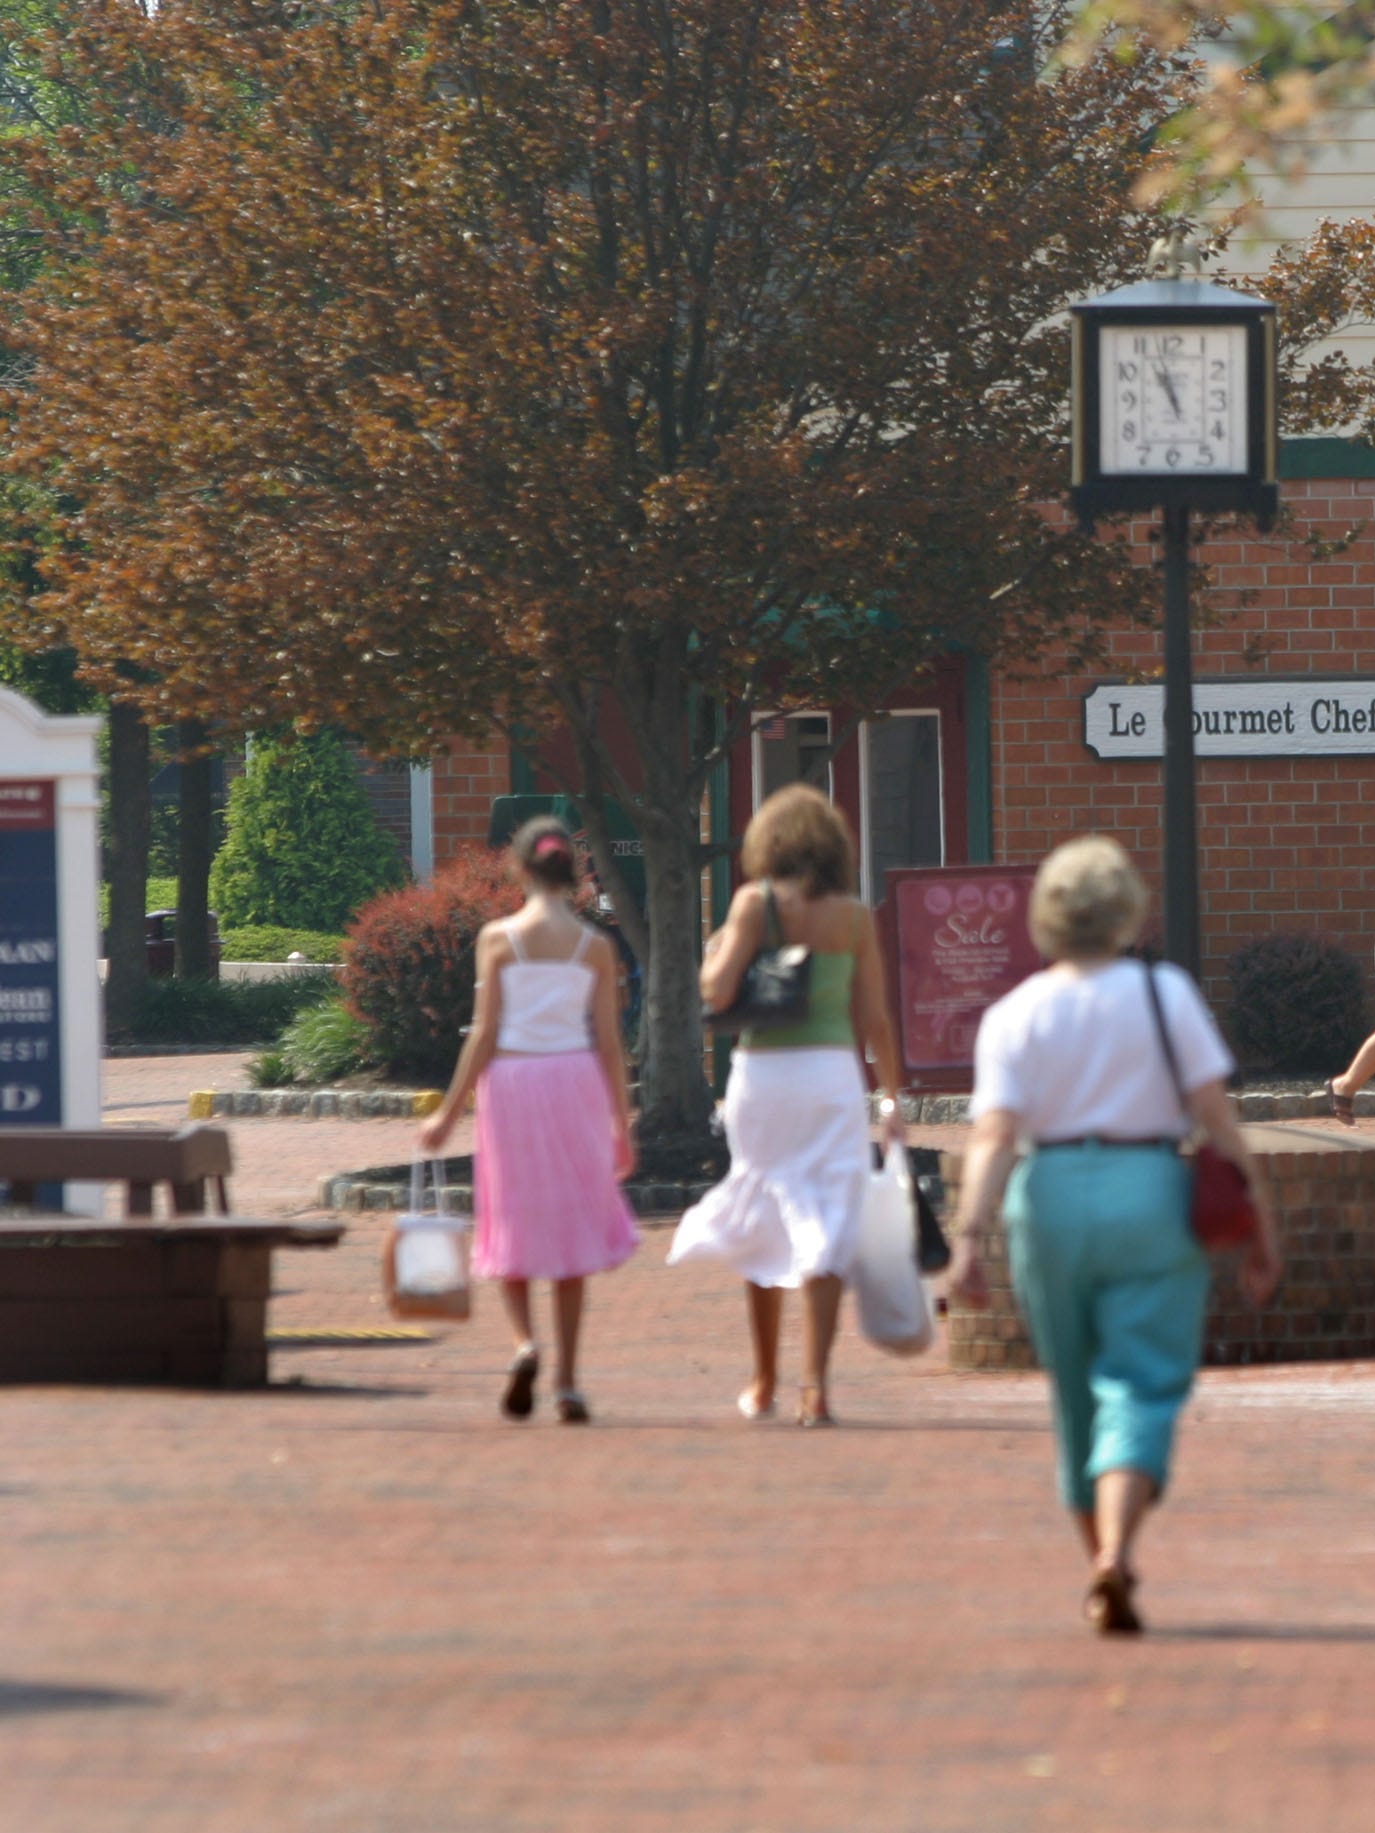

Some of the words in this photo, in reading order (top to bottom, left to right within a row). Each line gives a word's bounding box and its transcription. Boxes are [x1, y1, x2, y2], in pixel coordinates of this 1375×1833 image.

[1133, 338, 1147, 355] 11
[1162, 337, 1183, 355] 12
[1117, 362, 1138, 382] 10
[1210, 361, 1226, 381] 2
[1121, 391, 1137, 411] 9
[1208, 390, 1227, 412] 3
[1122, 419, 1136, 442] 8
[1210, 420, 1225, 441] 4
[1136, 444, 1152, 466] 7
[1165, 447, 1182, 468] 6
[1194, 444, 1214, 467] 5
[1108, 703, 1147, 737] Le
[1164, 702, 1296, 736] ourmet
[934, 913, 1006, 948] Sale
